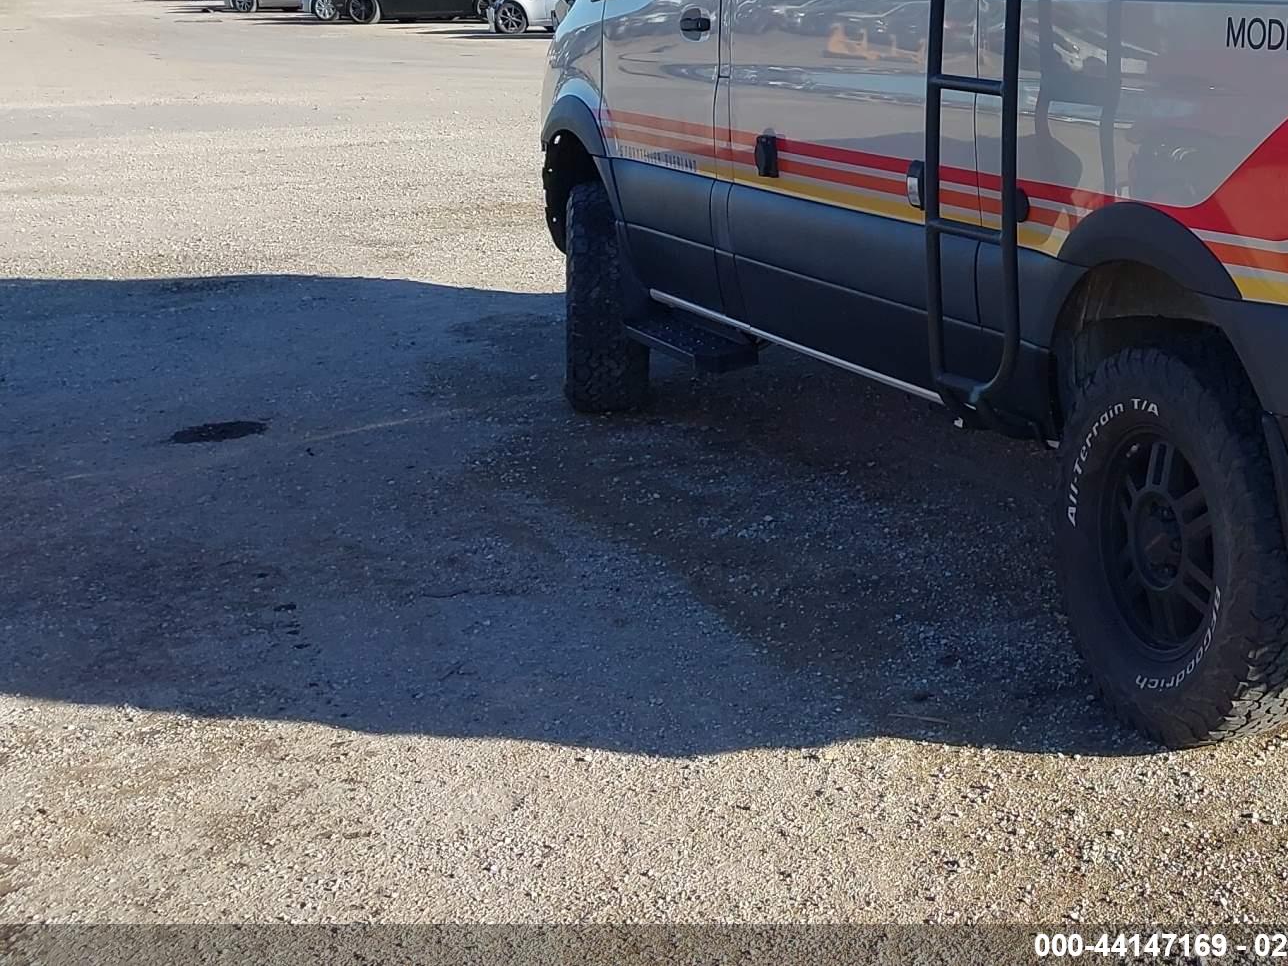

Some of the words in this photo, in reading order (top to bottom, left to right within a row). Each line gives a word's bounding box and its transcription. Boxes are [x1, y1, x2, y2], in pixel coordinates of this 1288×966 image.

[1067, 402, 1124, 527] All-Terrain
[1131, 398, 1160, 417] T/A
[1135, 585, 1221, 692] BFGoodrich
